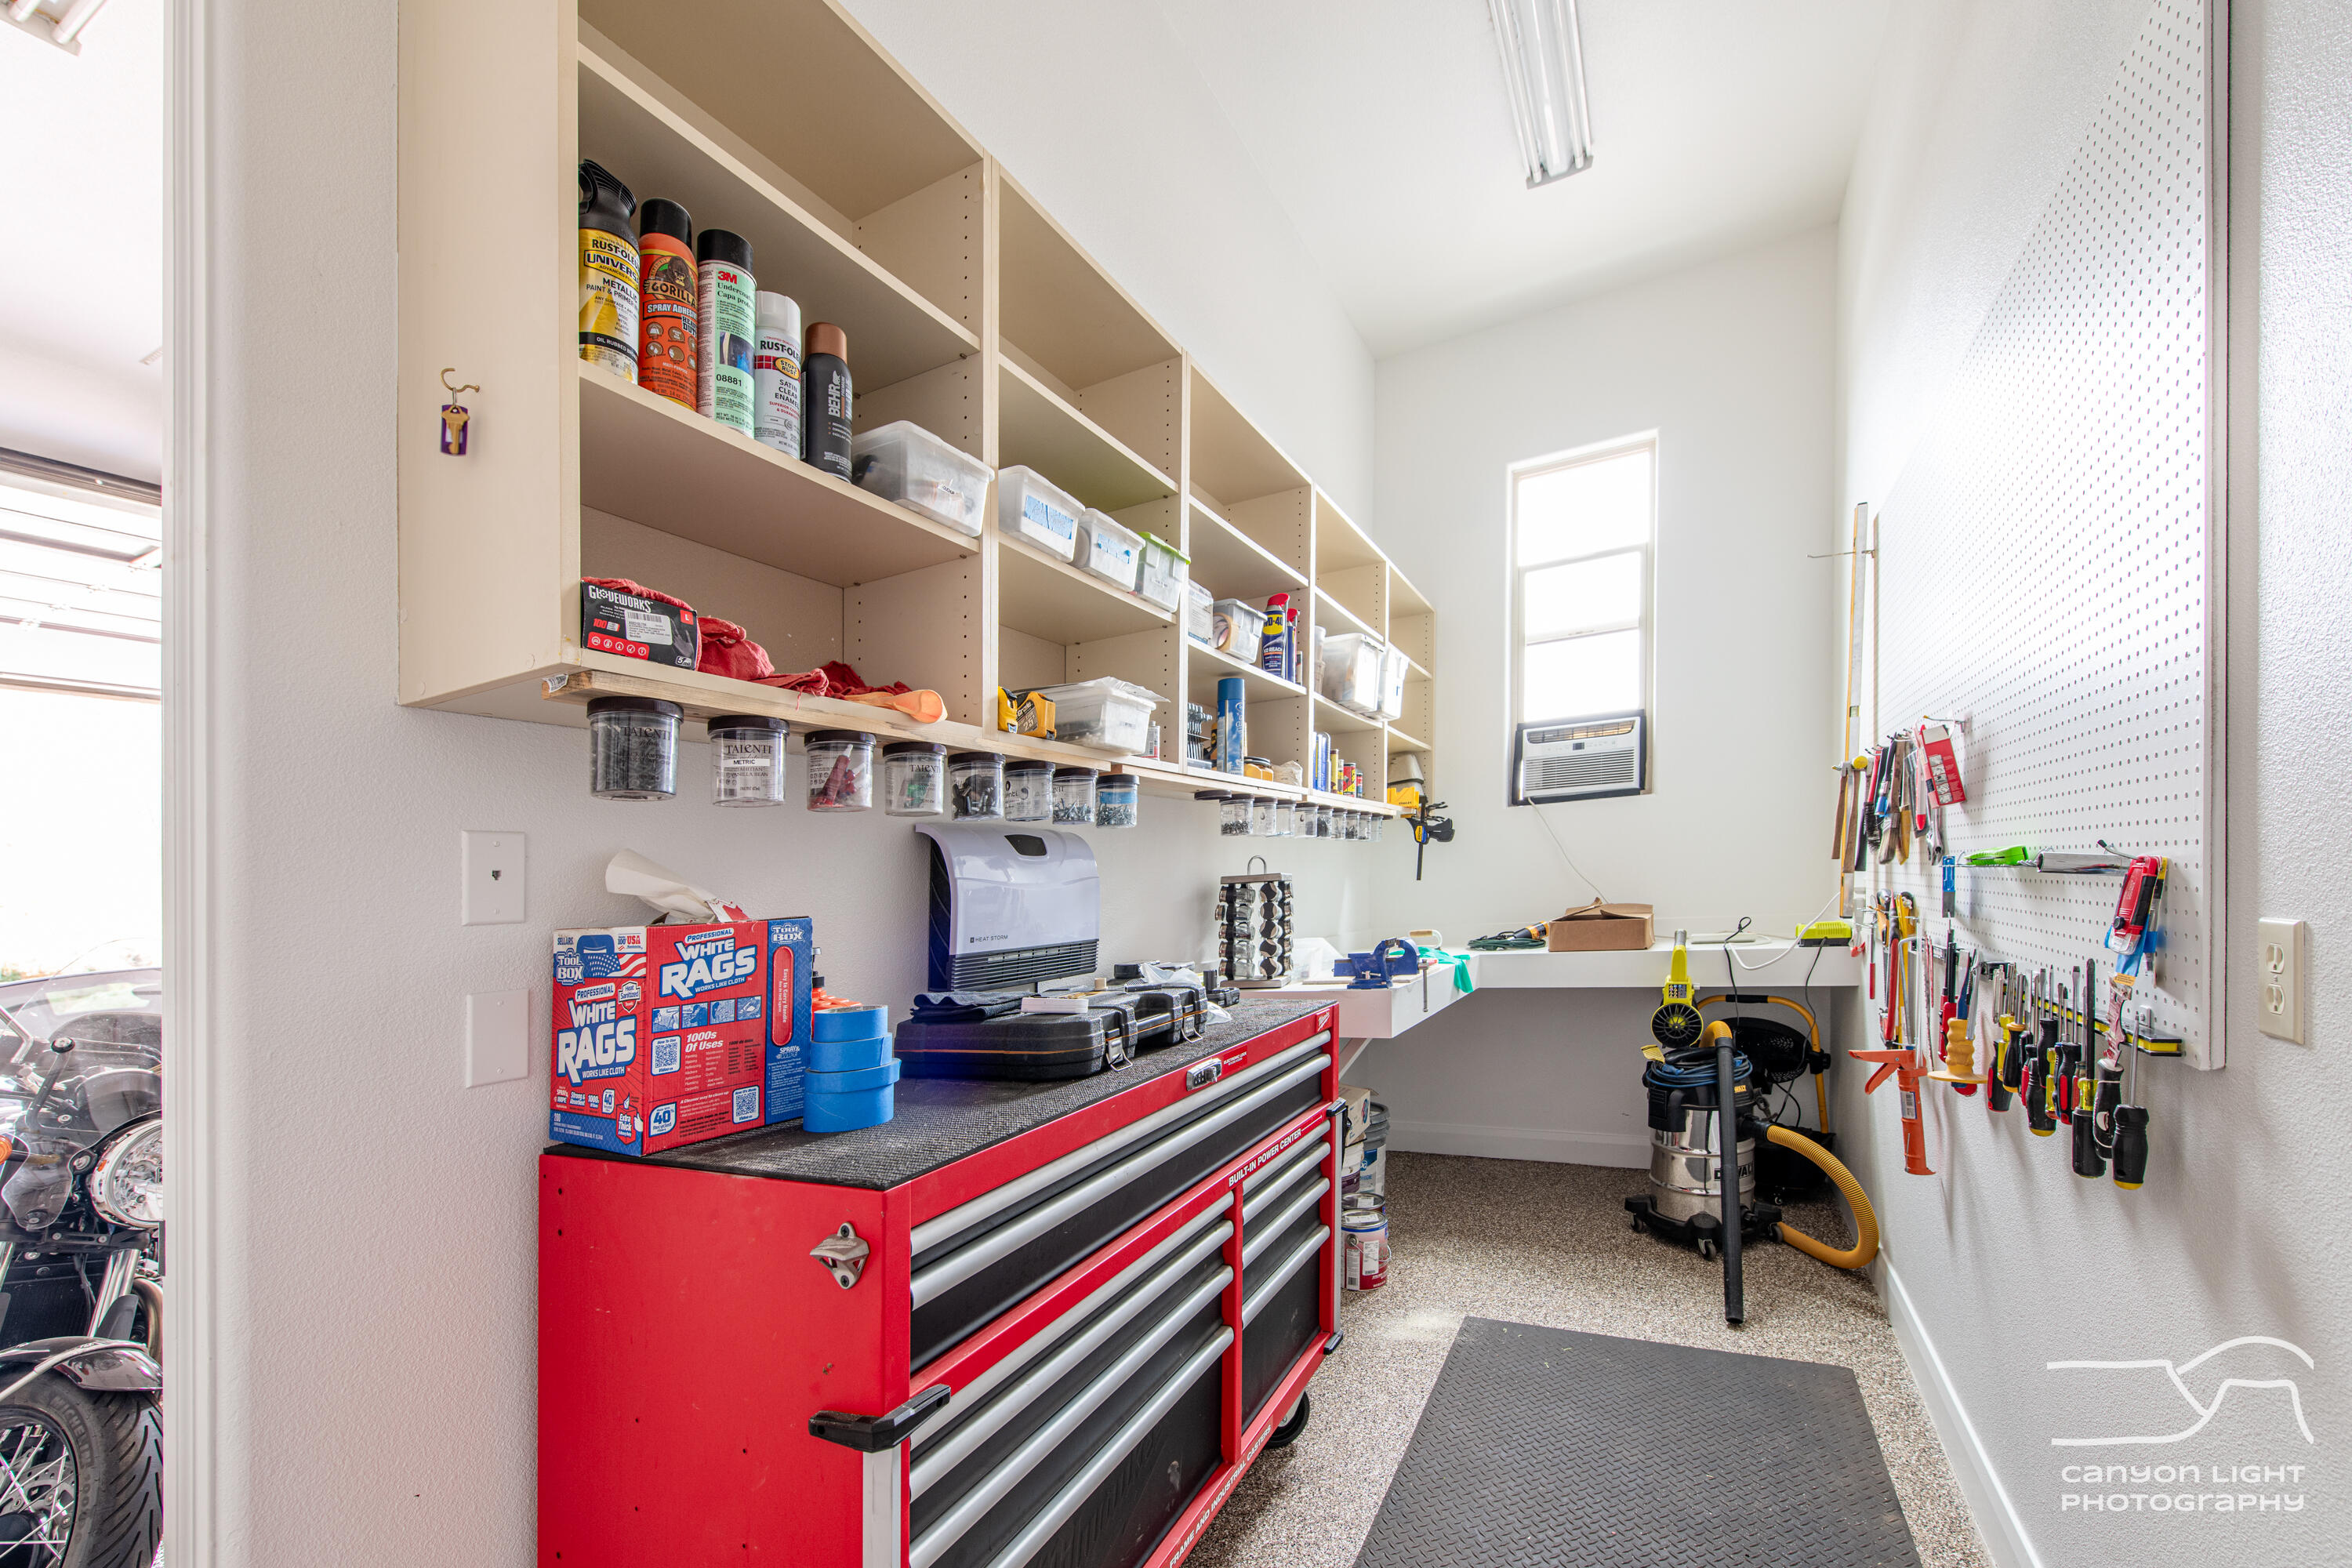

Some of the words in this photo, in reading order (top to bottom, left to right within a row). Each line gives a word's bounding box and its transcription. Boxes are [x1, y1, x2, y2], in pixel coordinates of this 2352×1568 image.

[717, 270, 738, 285] 3M
[586, 283, 606, 292] PAINT
[614, 290, 634, 306] PRIMER
[652, 282, 697, 309] GORILLA
[717, 290, 735, 300] Capa
[648, 303, 672, 314] SPRAY
[606, 339, 627, 352] RUBBED
[780, 360, 797, 372] STOPS
[782, 365, 797, 376] RUST
[716, 373, 742, 387] 08881
[779, 379, 797, 393] SATIN
[775, 392, 800, 409] ENAMEL
[779, 386, 798, 401] CLEAR
[828, 383, 841, 418] BEHR
[593, 618, 608, 628] 100
[724, 744, 773, 754] TALENTI
[627, 935, 641, 945] USA
[687, 928, 732, 942] PROFESSIONAL
[772, 931, 803, 942] BOX
[675, 938, 735, 961] WHITE
[557, 954, 580, 966] TOOL
[557, 965, 583, 981] BOX
[661, 946, 756, 998] RAGS
[576, 984, 614, 1000] PROFESSIONAL
[695, 983, 715, 993] WORKS
[728, 977, 745, 985] CLOTH
[620, 990, 639, 1000] Sanitized
[568, 1000, 616, 1029] WHITE
[686, 1031, 717, 1044] 1000s
[557, 1018, 635, 1083] RAGS
[684, 1043, 698, 1053] Of
[698, 1040, 724, 1051] Uses
[582, 1069, 598, 1079] WORKS
[598, 1068, 609, 1076] LIKE
[609, 1065, 625, 1075] CLOTH
[571, 1091, 583, 1100] Strong
[1733, 1084, 1747, 1093] WALT
[619, 1112, 632, 1123] Extra
[618, 1121, 633, 1132] Thick
[1229, 1159, 1257, 1188] BUILT-IN
[1257, 1143, 1279, 1167] POWER
[1279, 1128, 1301, 1150] CENTER
[1169, 1530, 1195, 1568] FRAME
[1195, 1508, 1210, 1535] AND
[1210, 1461, 1247, 1512] INDUSTRIAL
[1247, 1423, 1272, 1462] CASTERS
